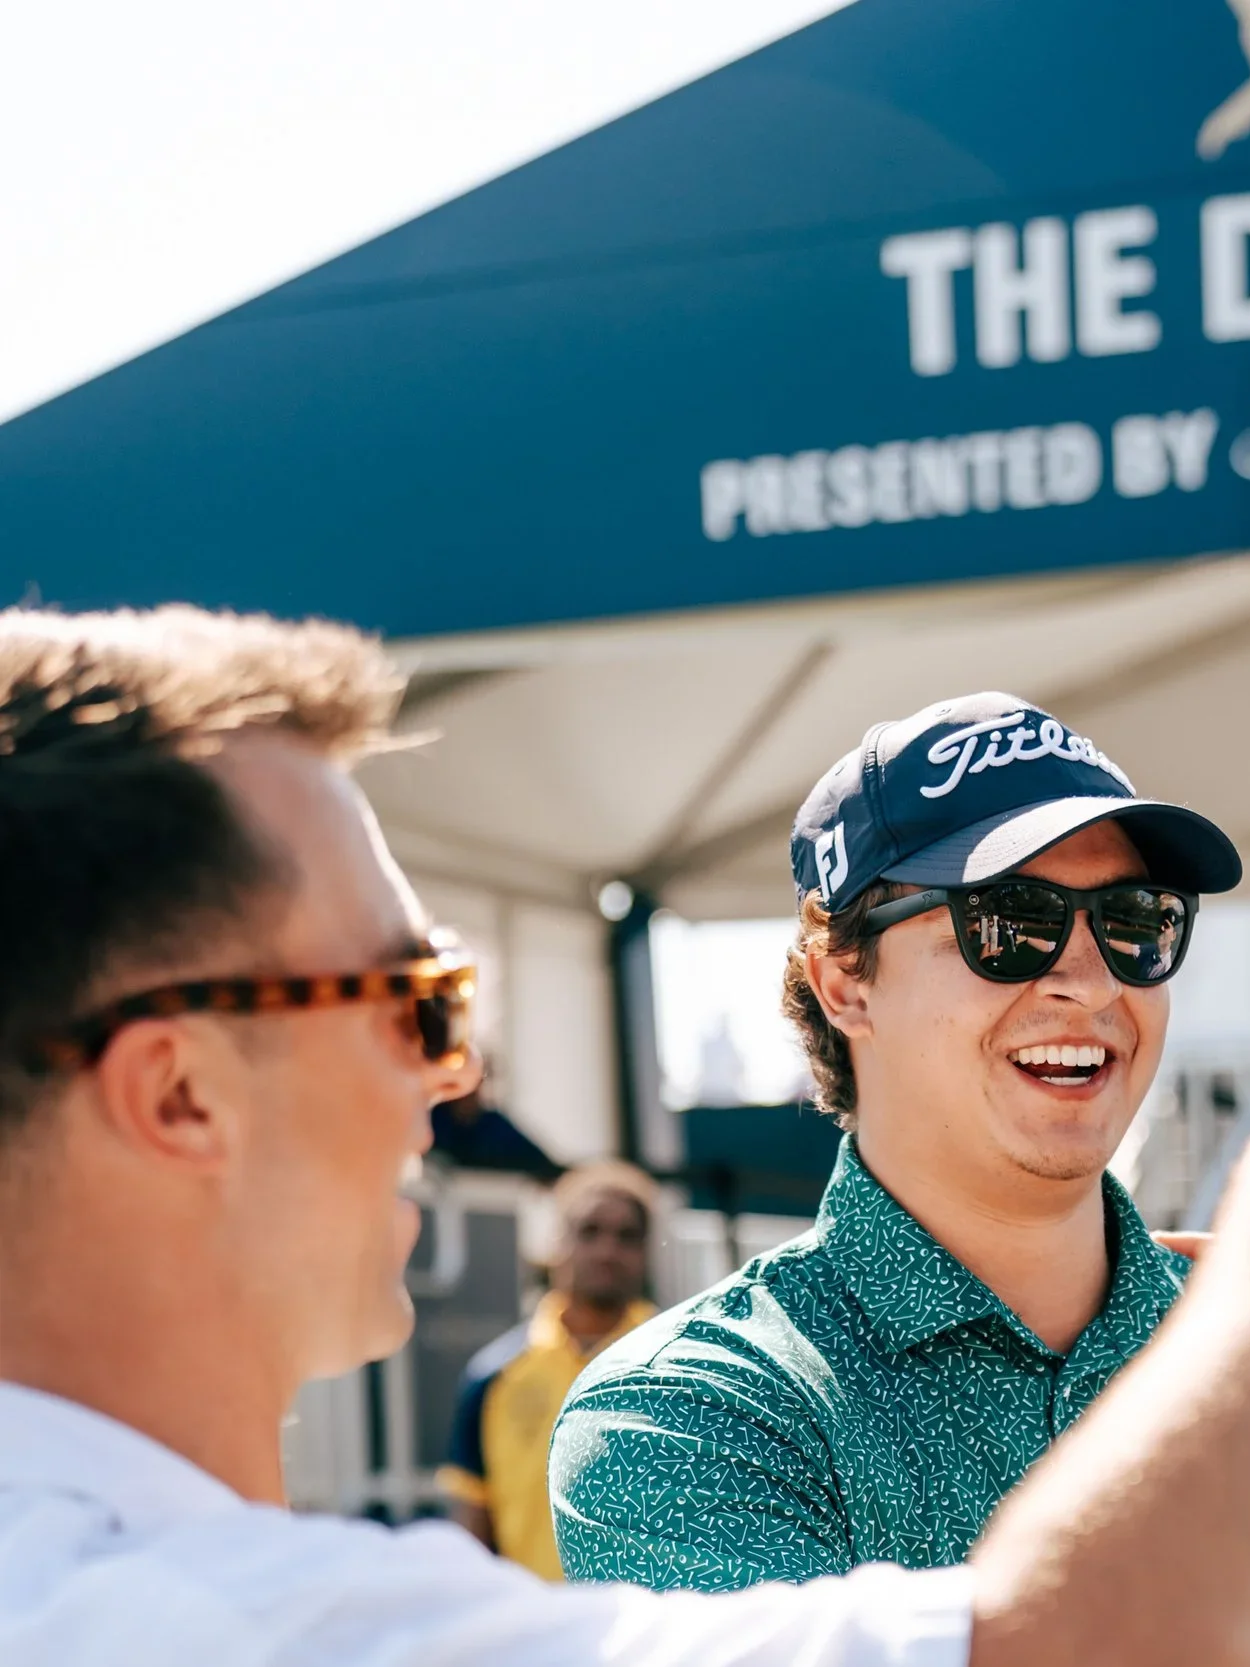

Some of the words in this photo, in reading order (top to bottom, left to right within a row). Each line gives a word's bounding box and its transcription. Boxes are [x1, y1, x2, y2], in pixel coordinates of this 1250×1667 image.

[880, 205, 1160, 376] THE
[701, 422, 1101, 541] PRESENTED
[1112, 408, 1216, 497] BY
[815, 820, 848, 904] FJ
